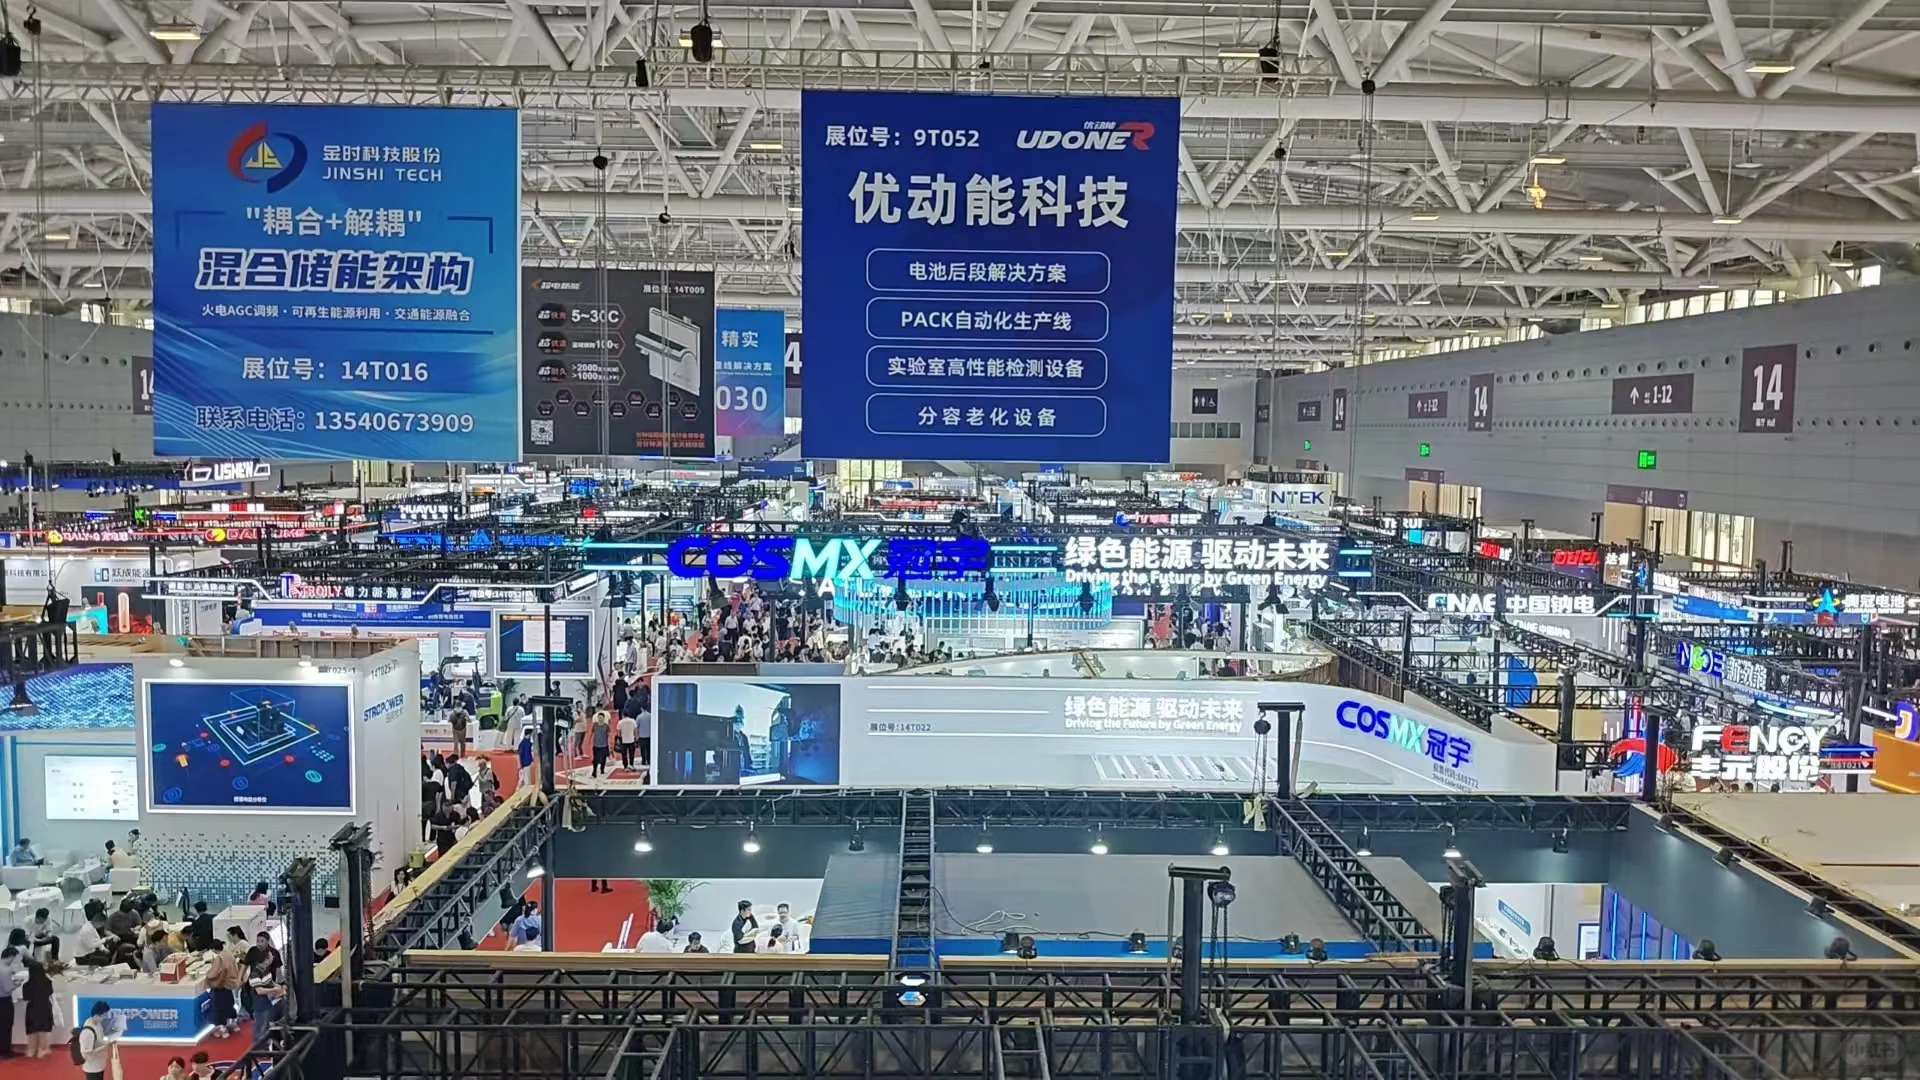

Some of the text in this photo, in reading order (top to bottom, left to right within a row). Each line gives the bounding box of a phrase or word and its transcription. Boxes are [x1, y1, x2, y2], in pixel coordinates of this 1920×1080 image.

[322, 145, 442, 164] 金时科技股份
[322, 168, 442, 183] JINSHI TECH
[849, 171, 1129, 229] 优动能科技
[195, 247, 474, 295] 混合储能架构
[909, 262, 1067, 283] 电池后段解决方案
[901, 310, 1072, 331] PACK自动化生产线
[721, 330, 759, 348] 精实
[887, 357, 1085, 378] 实验室高性能检测设备
[1652, 384, 1673, 404] 1-12
[1752, 364, 1784, 411] 14
[1473, 386, 1488, 417] 14
[918, 406, 1057, 427] 分容老化设备
[1271, 490, 1325, 505] NTEK
[667, 537, 992, 581] COSMX 冠宇
[1064, 536, 1330, 571] 绿色能源 驱动未来
[1065, 569, 1329, 588] Driving the Future by Green Energy
[1505, 594, 1596, 614] 中国钠电
[1064, 695, 1243, 720] 绿色能源 驱动未来
[1065, 719, 1243, 733] Driving the Future by Green Energy
[1336, 700, 1472, 768] COSMX 冠宇
[1691, 754, 1820, 782] 丰元股份
